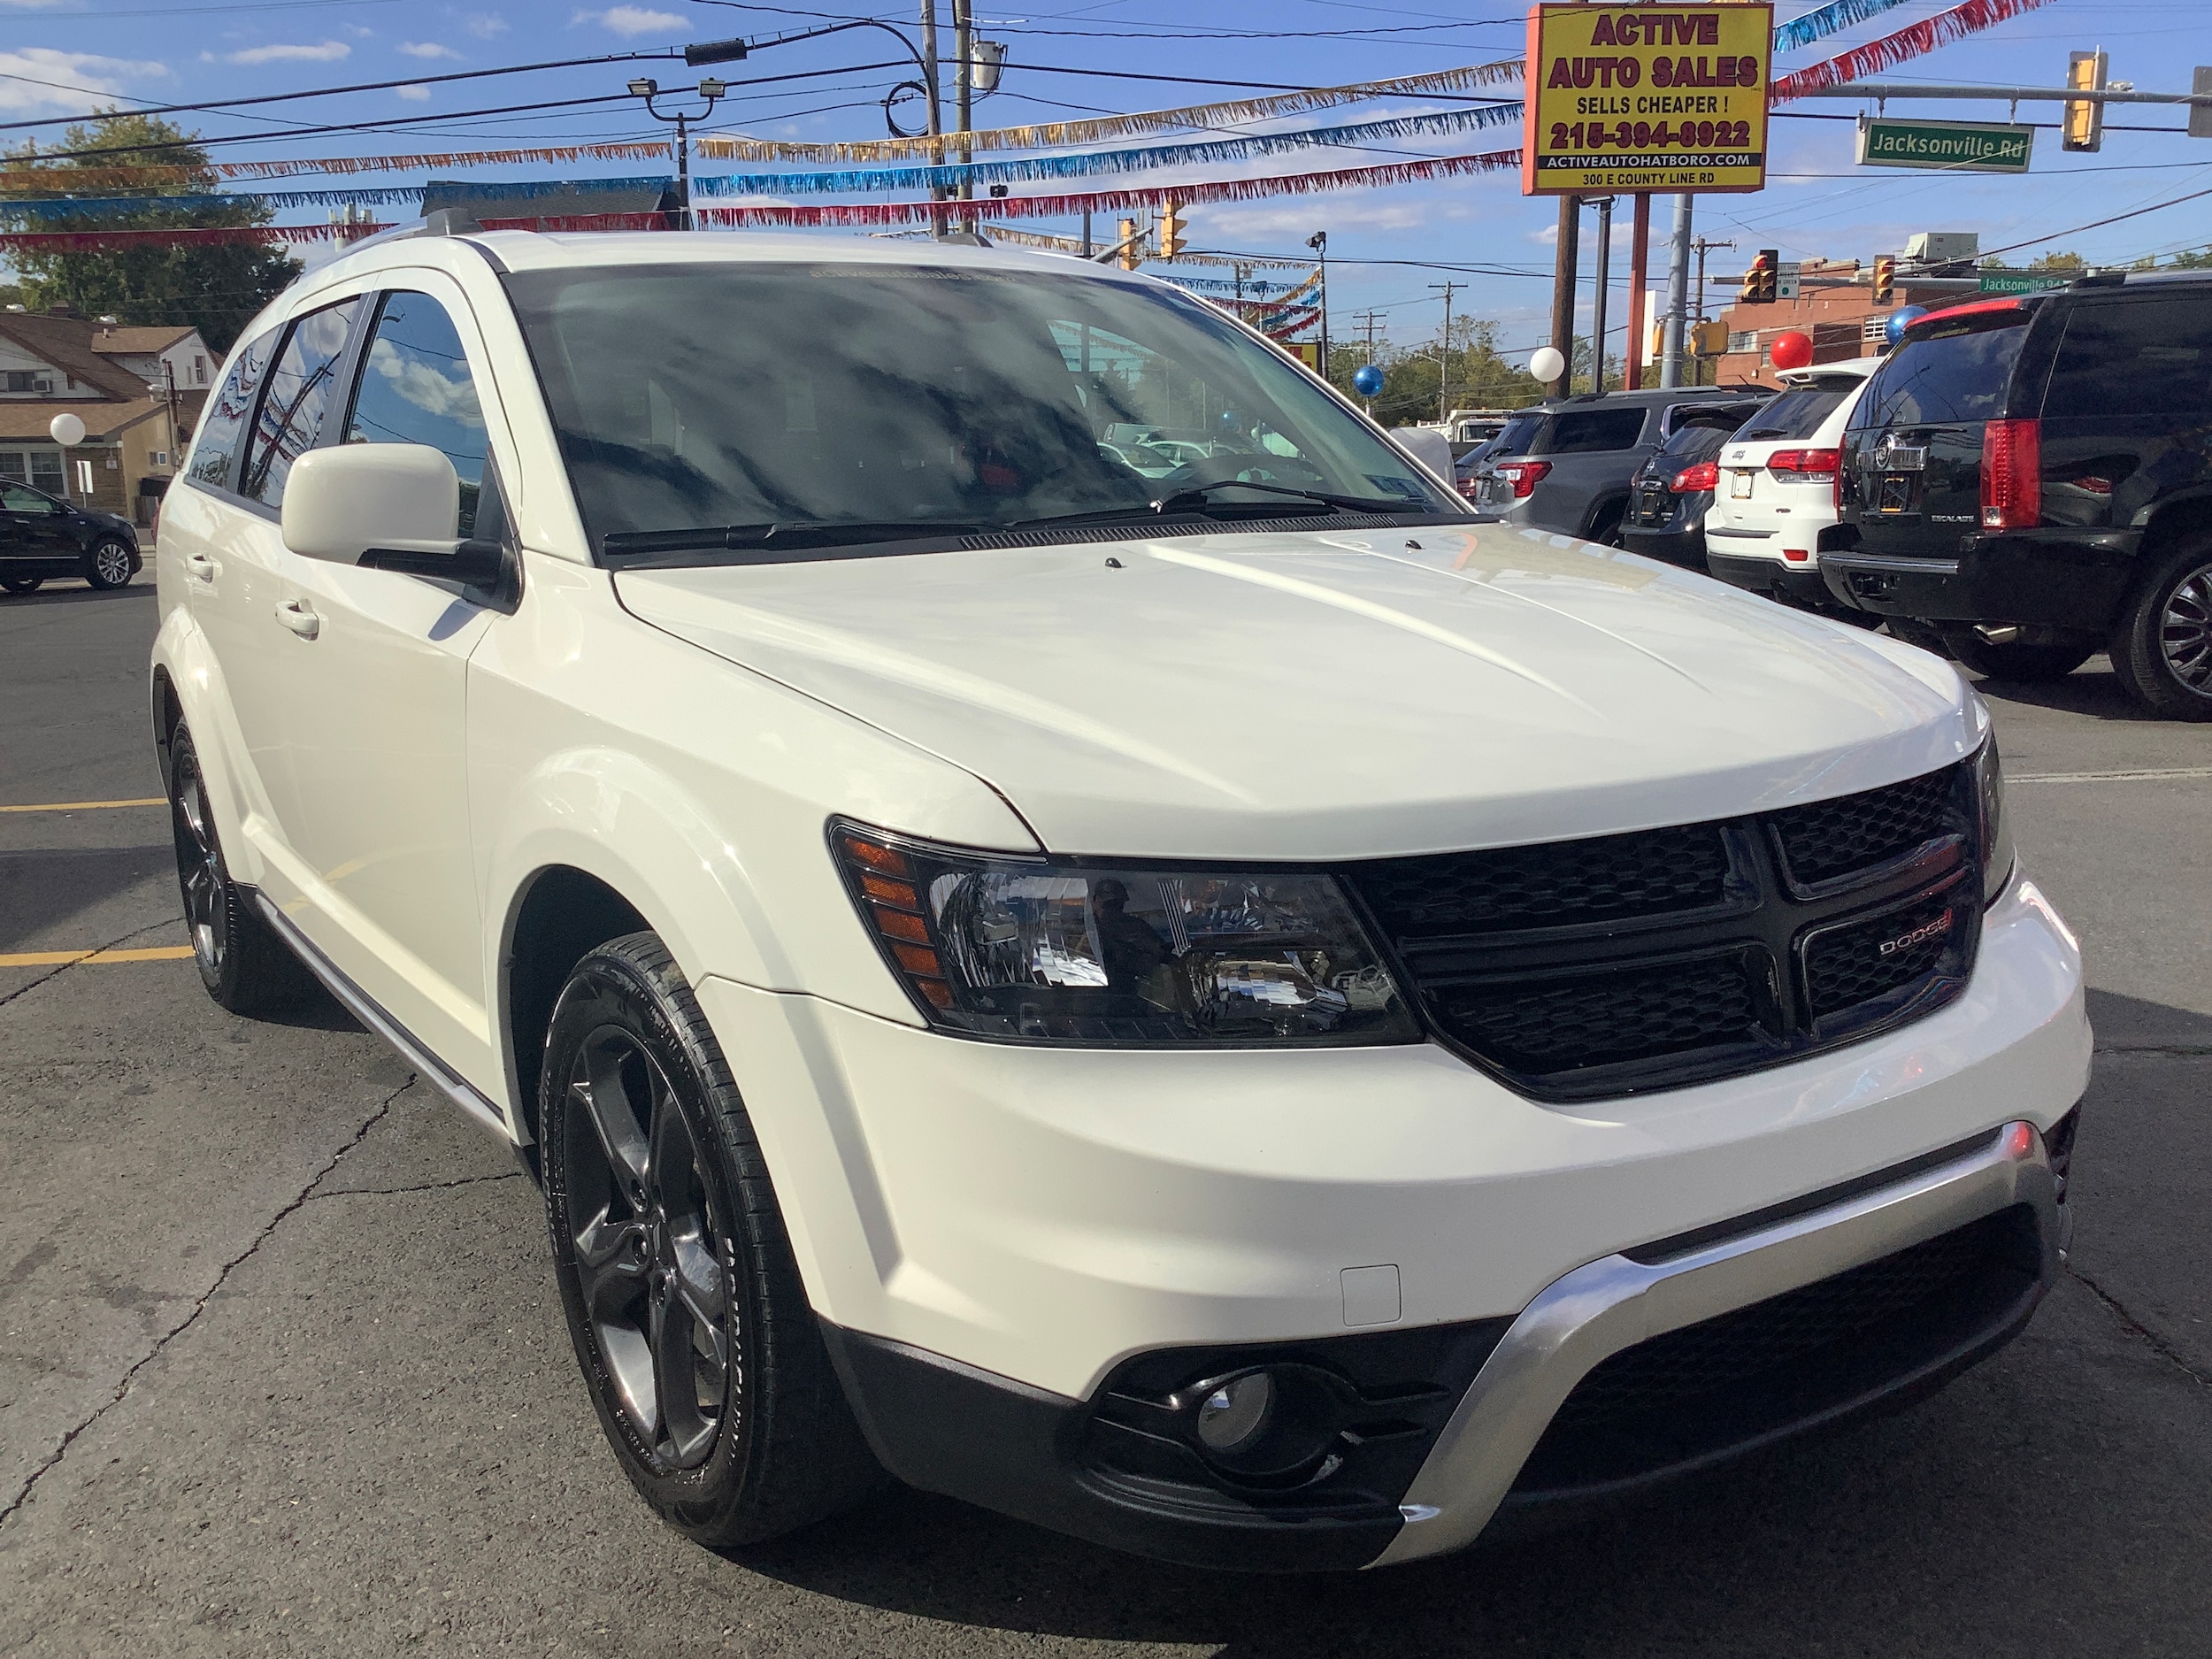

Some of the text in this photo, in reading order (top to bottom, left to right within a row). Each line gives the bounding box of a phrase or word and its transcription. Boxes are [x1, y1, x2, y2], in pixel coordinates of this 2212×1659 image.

[1590, 14, 1719, 45] ACTIVE
[1548, 56, 1758, 88] AUTO SALES
[1577, 96, 1630, 115] SELLS
[1637, 96, 1717, 113] CHEAPER
[1550, 120, 1750, 150] 215-394-8922
[1873, 133, 2024, 157] Jacksonville Rd
[1547, 154, 1750, 168] ACTIVEAUTOHATBORO.COM
[1583, 173, 1715, 185] 300 E COUNTY LINE RD
[1984, 278, 2045, 292] Jacksonville
[1879, 914, 1949, 956] DODGE
